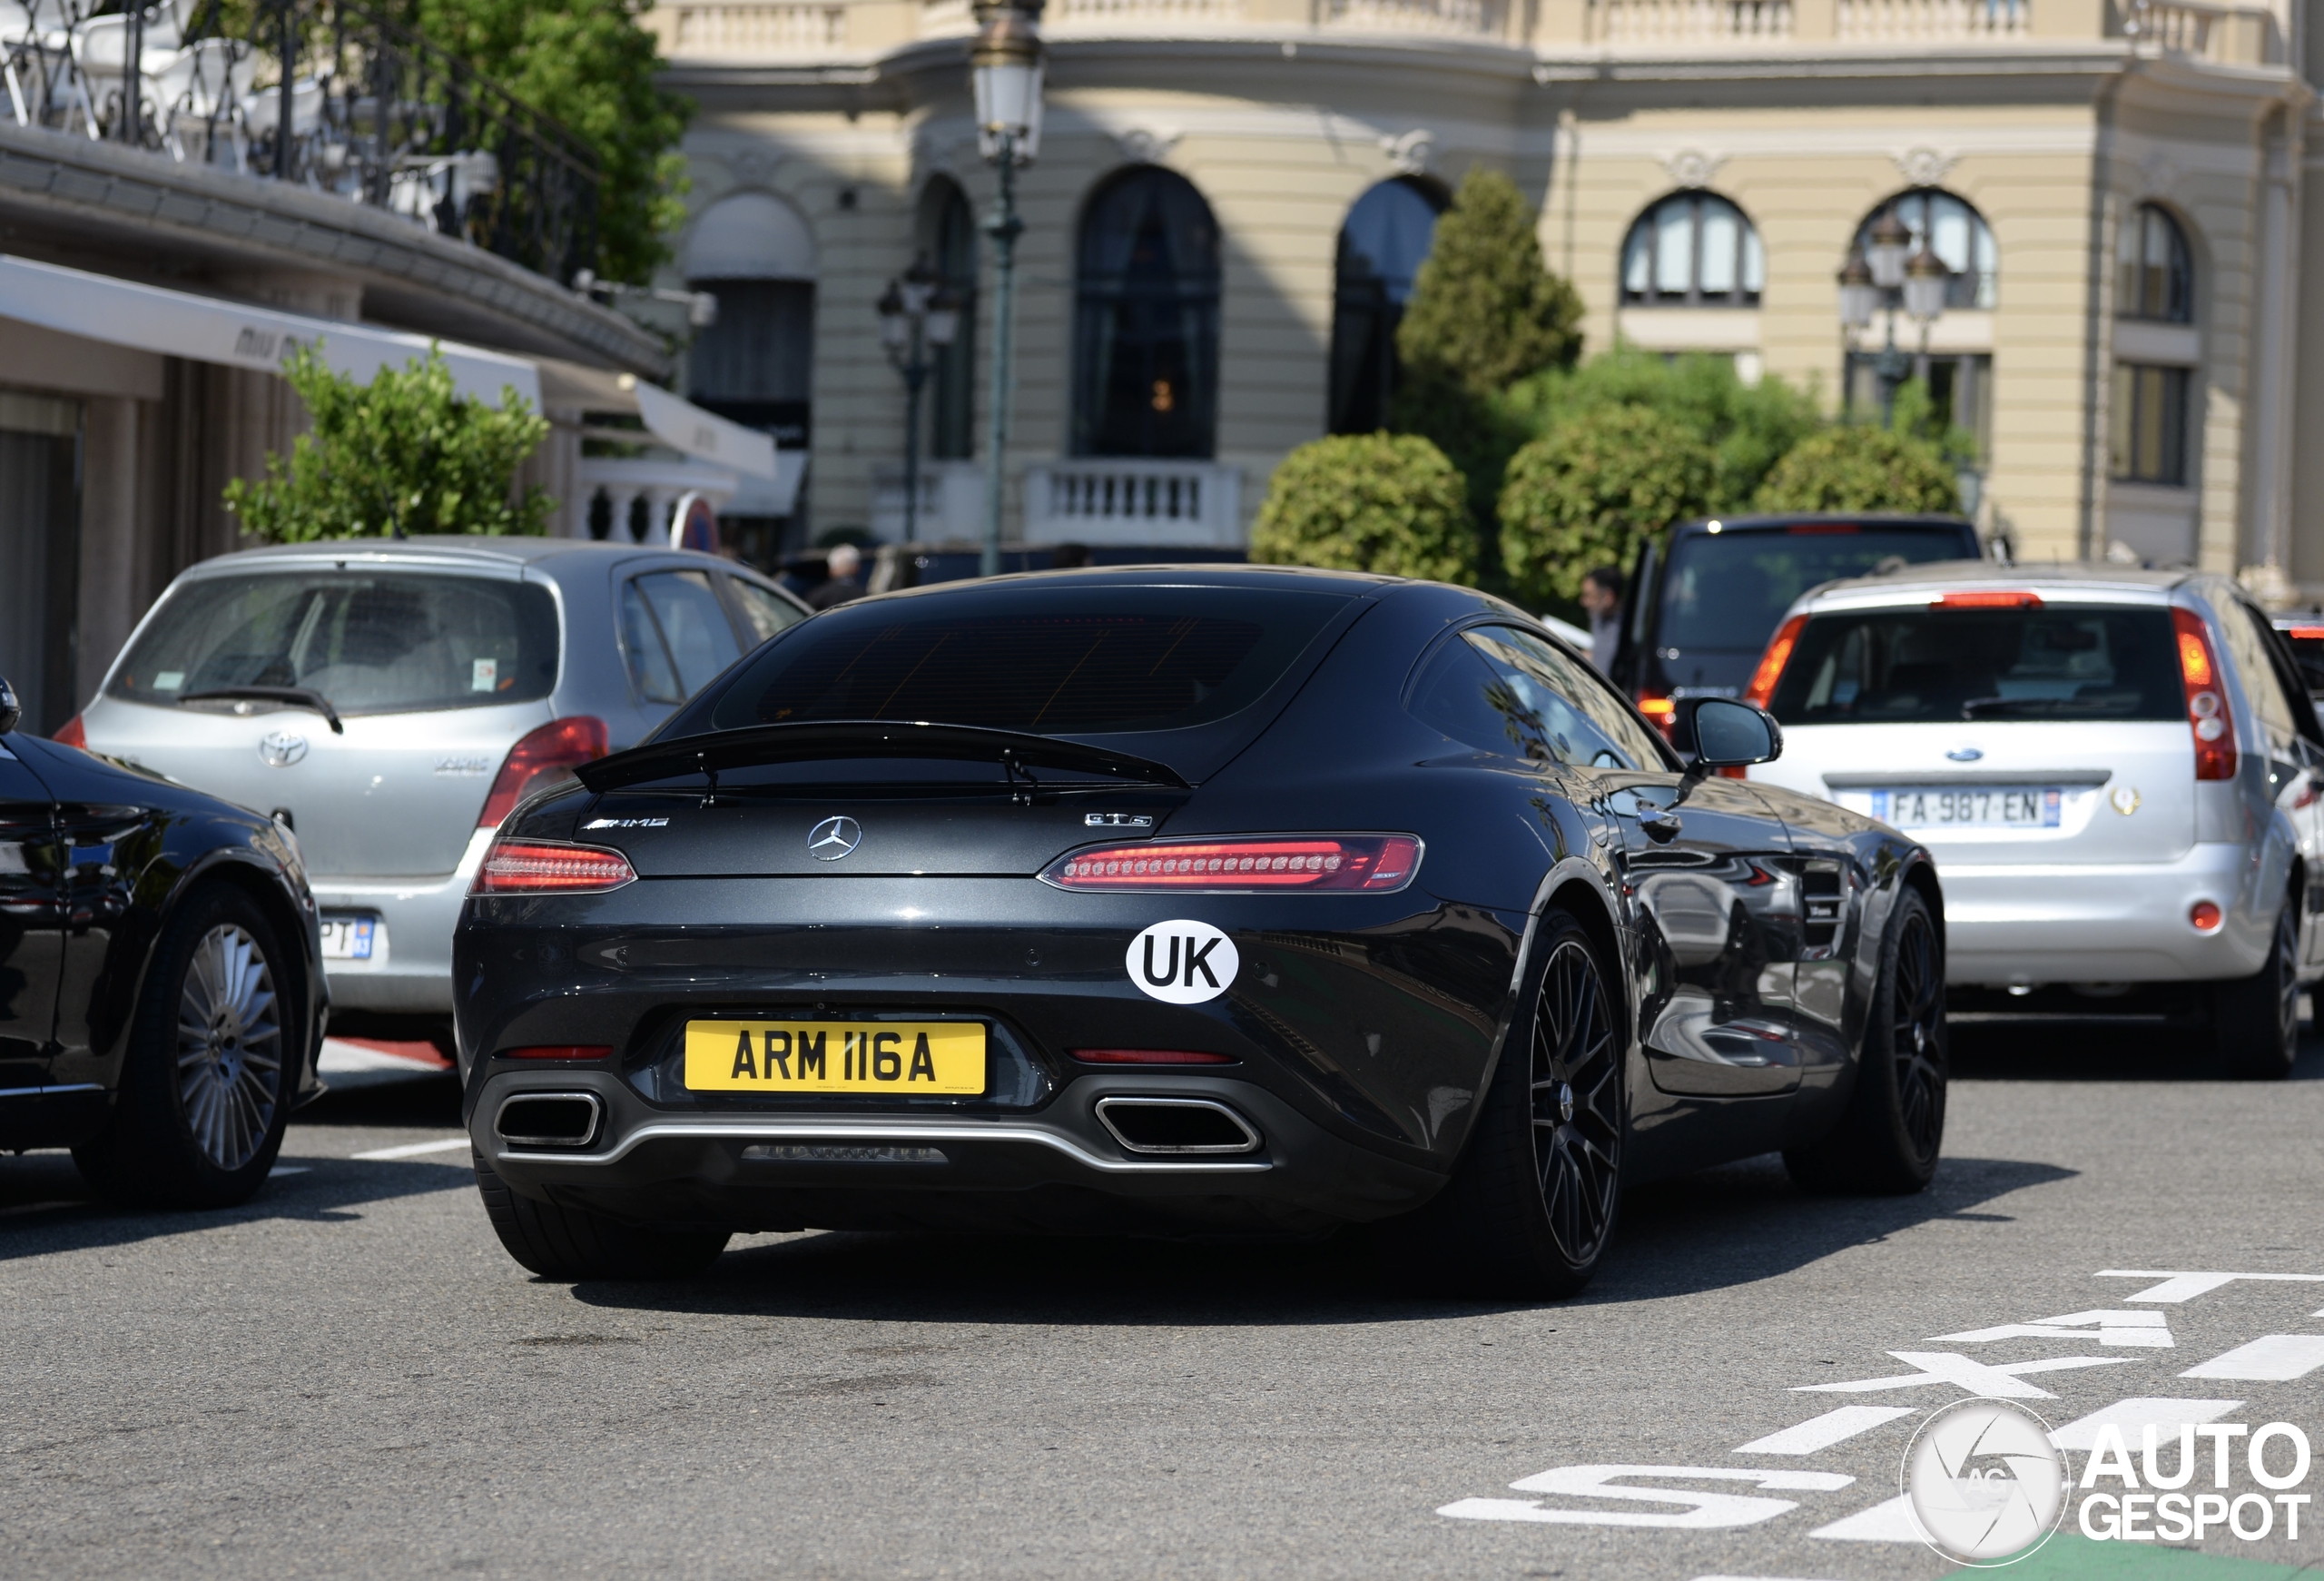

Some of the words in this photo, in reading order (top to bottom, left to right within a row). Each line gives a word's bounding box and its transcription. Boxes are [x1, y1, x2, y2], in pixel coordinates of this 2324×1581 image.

[608, 817, 670, 828] AMG
[1143, 934, 1223, 989] UK
[730, 1029, 827, 1081] ARM
[843, 1031, 937, 1082] 116A
